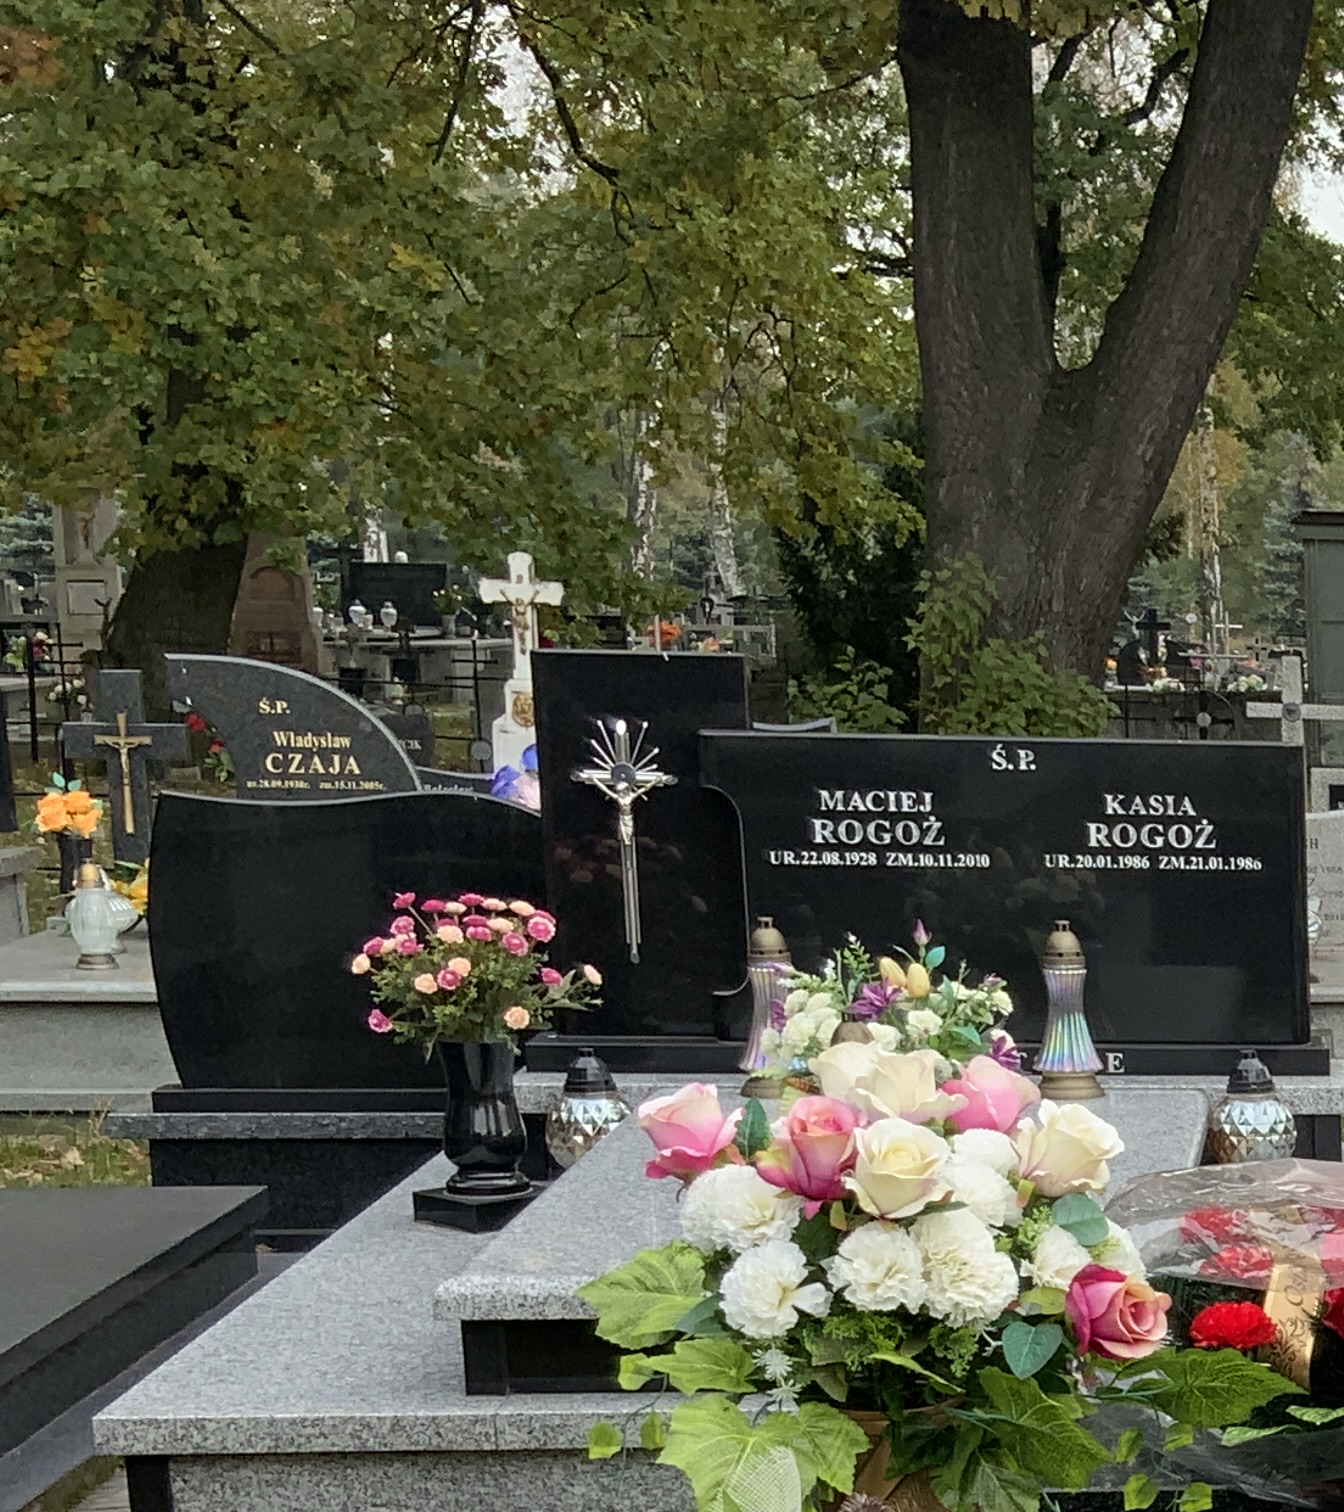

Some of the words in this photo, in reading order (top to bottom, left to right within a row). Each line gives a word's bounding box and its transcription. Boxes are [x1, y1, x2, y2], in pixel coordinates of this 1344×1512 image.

[265, 752, 361, 775] CZAJA
[819, 790, 934, 814] MACIEJ
[1104, 795, 1197, 818] KASIA
[811, 816, 946, 847] ROGOŻ
[1087, 818, 1218, 850] ROGOŻ
[769, 850, 878, 866] UR.22.08.1928
[885, 852, 991, 868] ZM.10.11.2010
[1044, 854, 1150, 869] UR.20.01.1986
[1158, 855, 1263, 871] ZM.21.01.1986
